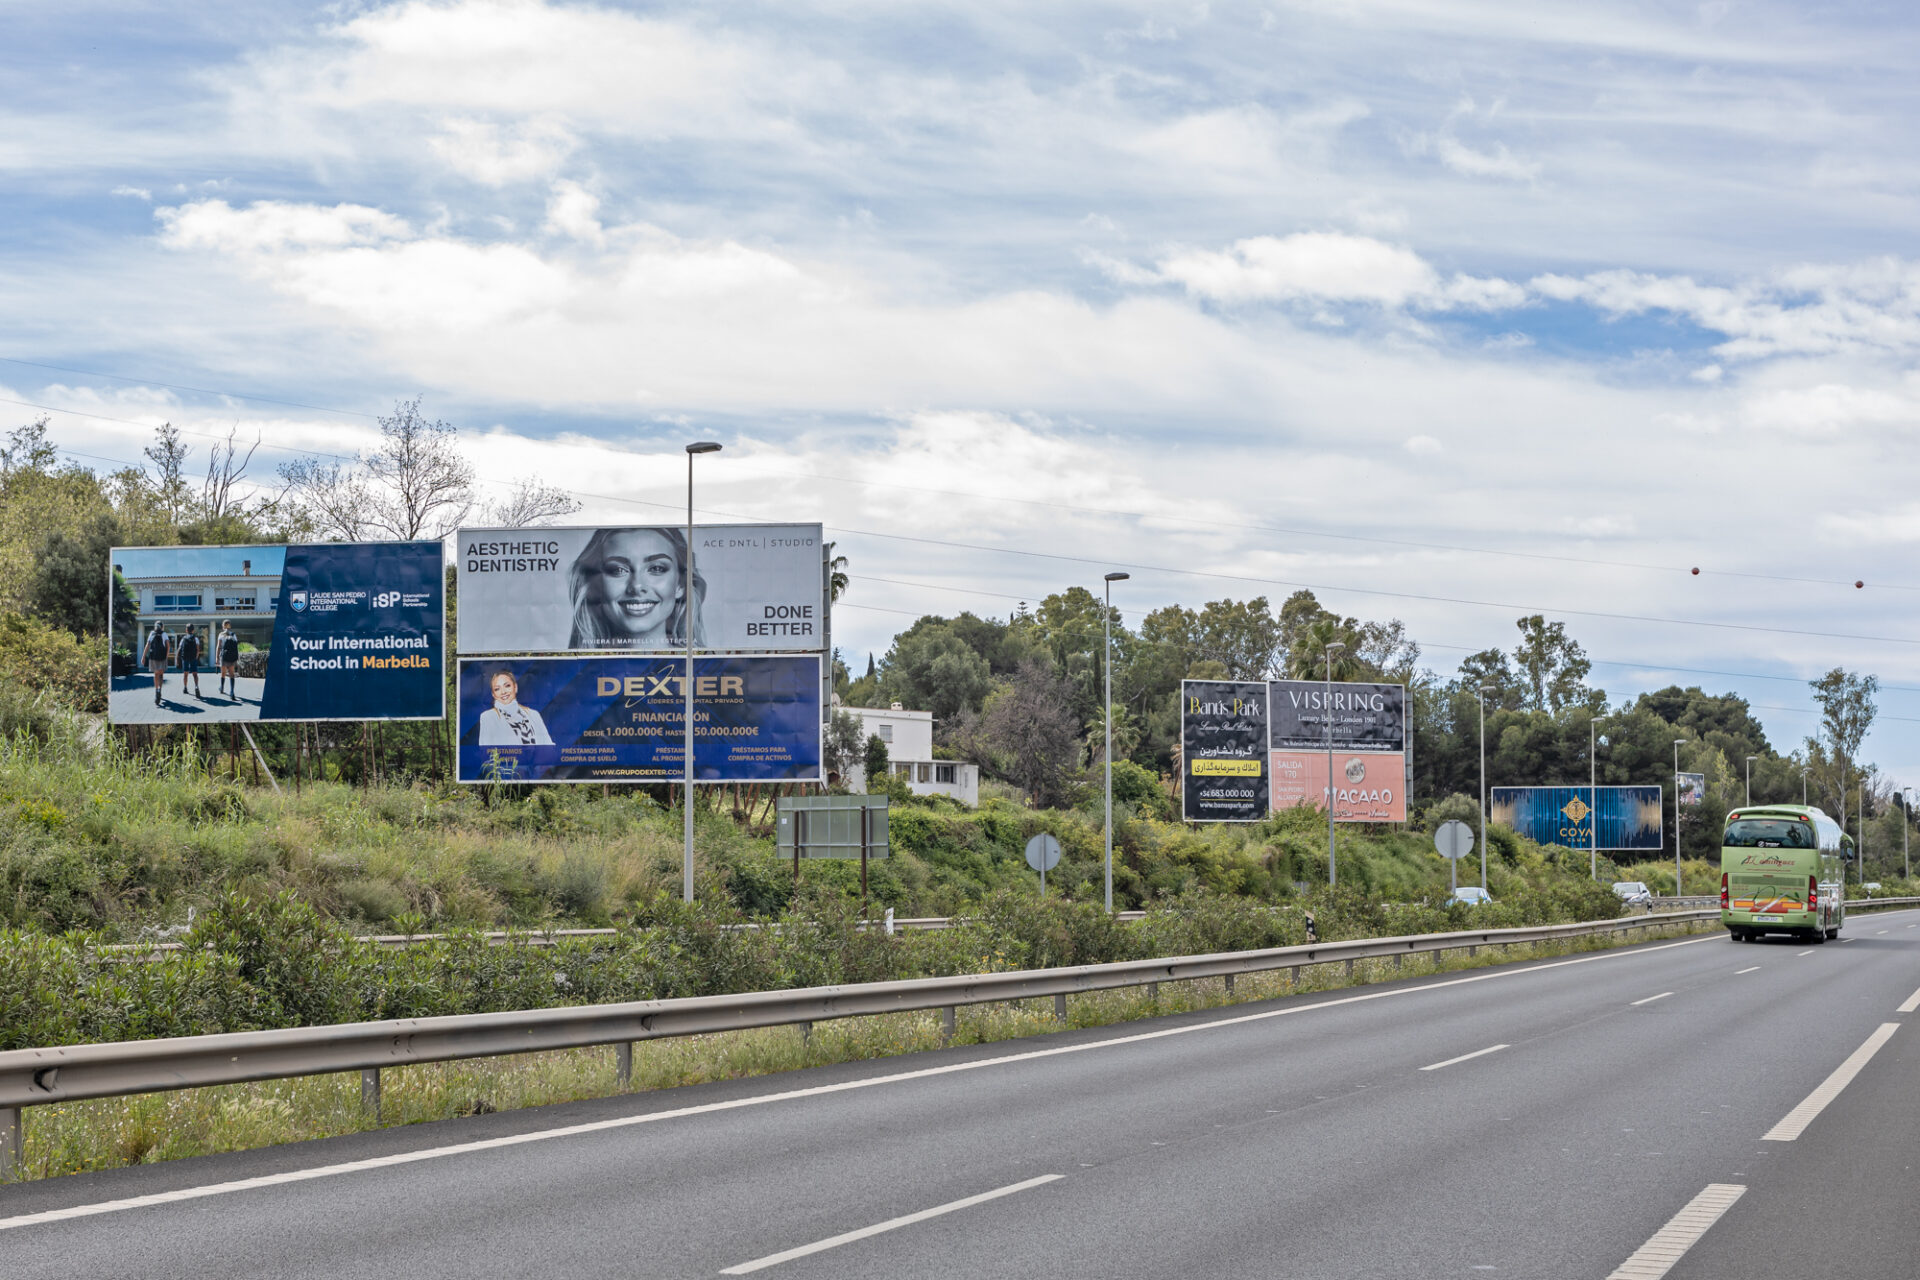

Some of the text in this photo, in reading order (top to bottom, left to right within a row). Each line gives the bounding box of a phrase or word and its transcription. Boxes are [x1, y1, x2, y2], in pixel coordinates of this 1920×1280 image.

[467, 541, 559, 556] AESTHETIC
[703, 538, 813, 548] ACE DNTL STUDIO
[467, 558, 560, 573] DENTISTRY
[764, 605, 813, 619] DONE
[747, 622, 813, 636] BETTER
[290, 634, 429, 651] Your International
[290, 655, 430, 670] School in Marbella
[597, 676, 744, 697] DEXTER
[1190, 696, 1260, 717] Banús Park
[1289, 690, 1384, 712] VISPRING
[1298, 713, 1319, 724] Luxury
[1341, 715, 1363, 724] London
[606, 727, 664, 737] 1.000.000€
[694, 726, 759, 737] 50.000.000€
[1322, 726, 1352, 734] Mrbella
[1277, 760, 1303, 769] SALIDA
[1210, 789, 1224, 798] 683
[1225, 790, 1239, 798] 000
[1240, 790, 1255, 798] 000
[1559, 828, 1592, 837] COYA
